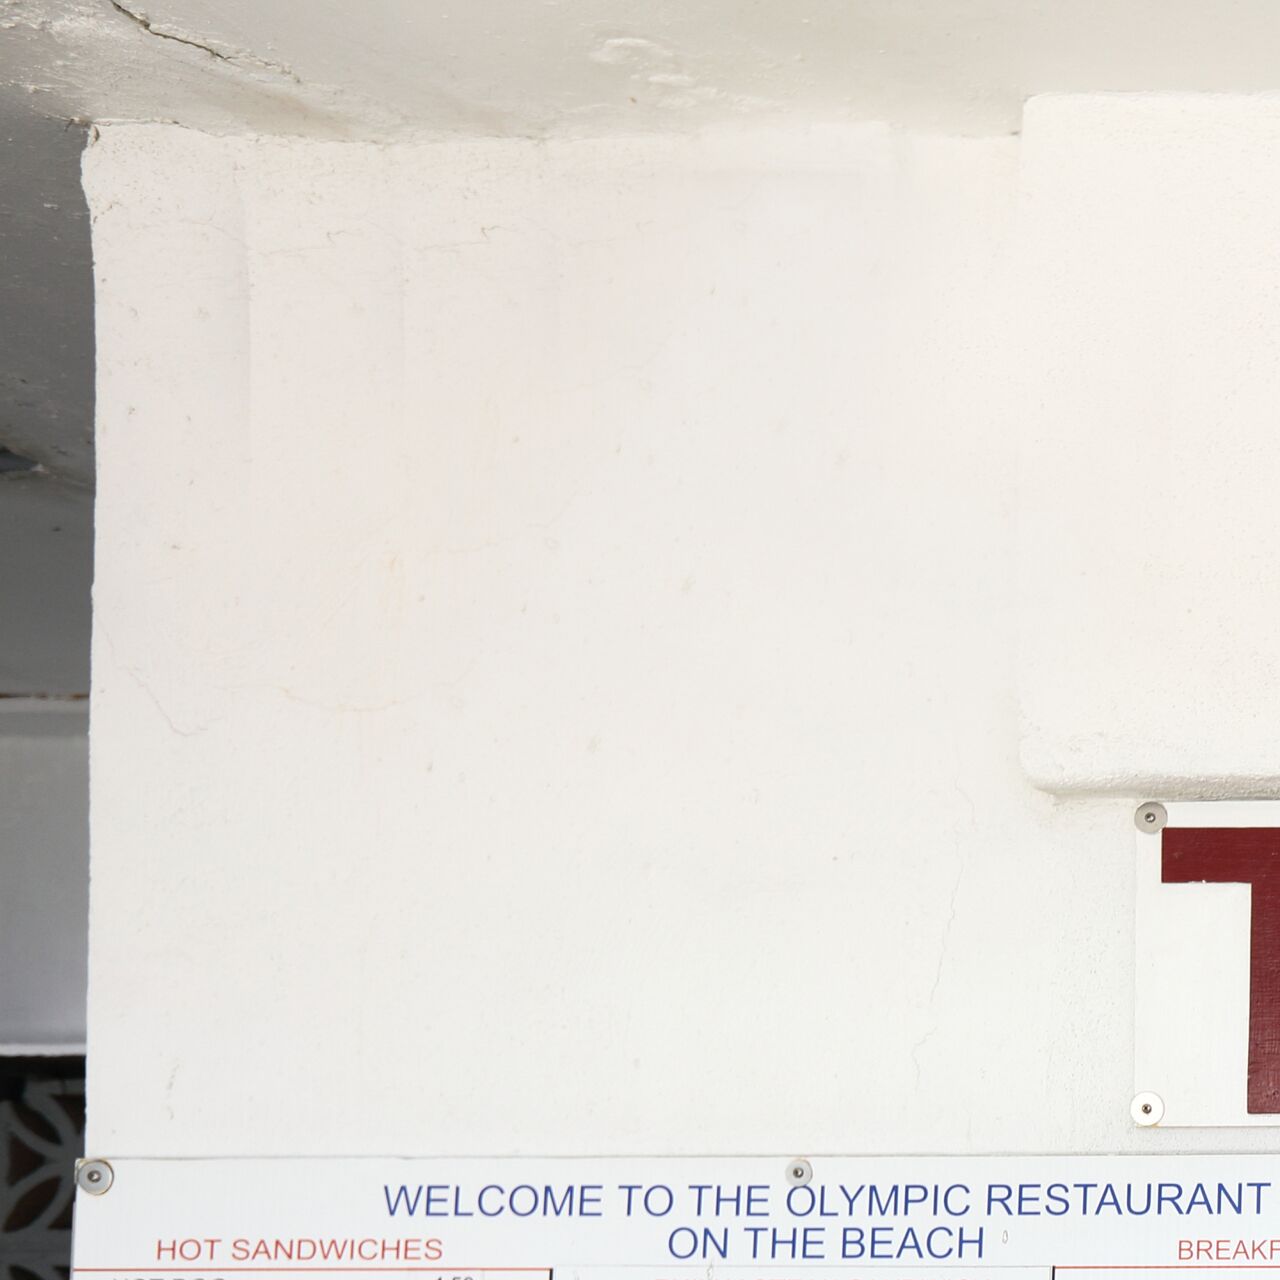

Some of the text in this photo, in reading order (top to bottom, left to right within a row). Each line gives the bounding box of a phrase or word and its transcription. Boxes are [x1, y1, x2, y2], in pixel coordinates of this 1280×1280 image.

[383, 1182, 1272, 1217] WELCOME TO THE OLYMPIC RESTAURANT
[156, 1238, 443, 1262] HOT SANDWICHES
[668, 1226, 984, 1260] ON THE BEACH
